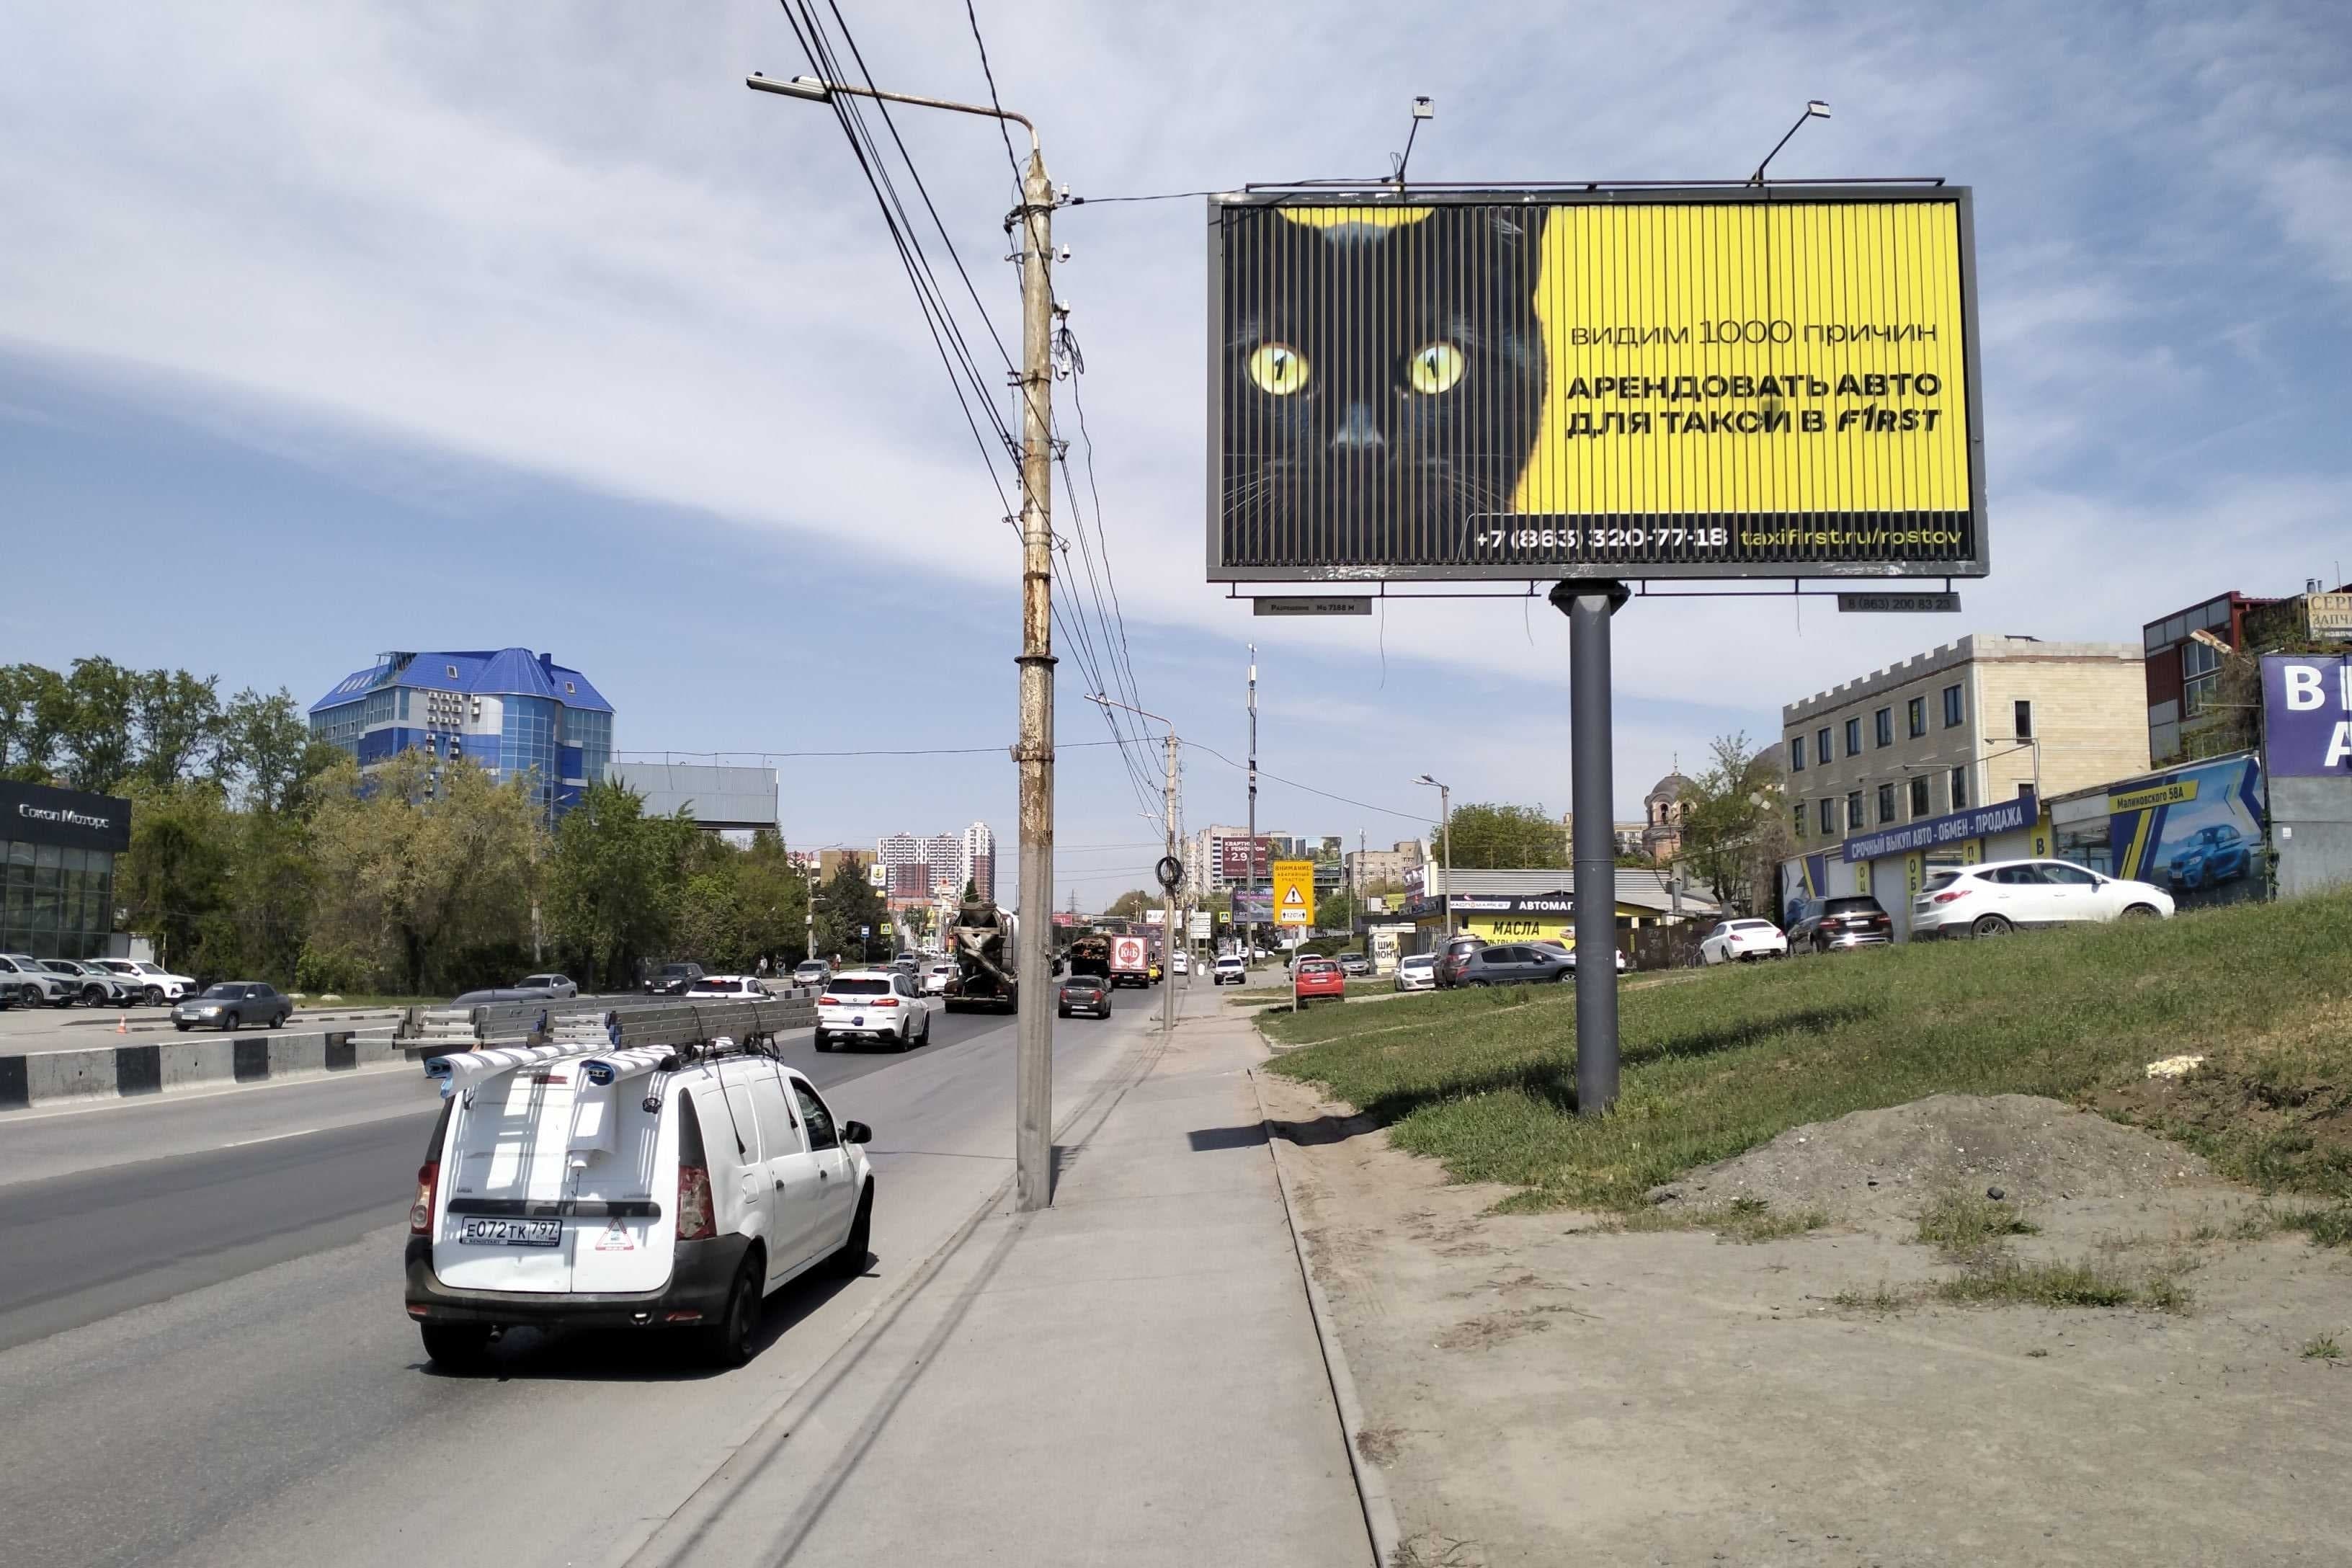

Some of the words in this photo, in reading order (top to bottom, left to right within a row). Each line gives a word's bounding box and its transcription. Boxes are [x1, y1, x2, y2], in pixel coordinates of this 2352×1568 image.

[1699, 320, 1793, 345] 1000
[1567, 373, 1830, 402] АРЕНДОВАТЬ
[1836, 373, 1943, 398] АВТО
[1567, 411, 1651, 438] ДЛЯ
[1660, 410, 1792, 435] ТАКСИ
[1802, 409, 1827, 433] В
[1474, 530, 1506, 548] +7
[1510, 528, 1584, 550] (863)
[1587, 527, 1728, 548] 320-77-18
[1740, 527, 1962, 547] taxifirst.ru/rostov
[1848, 600, 1856, 609] 8
[1859, 597, 1889, 610] (863)
[1892, 599, 1915, 609] 200
[1918, 599, 1933, 609] 83
[1936, 599, 1950, 609] 23
[2310, 596, 2352, 611] СЕР
[2312, 614, 2352, 625] ЗАПЧ
[2117, 791, 2168, 808] Малиновского
[2169, 786, 2184, 800] 58А
[19, 803, 60, 821] Сокол
[61, 809, 110, 829] Моторс
[1851, 833, 1885, 859] СРОЧНЫЙ
[1886, 831, 1911, 851] ВЫКУП
[1912, 827, 1933, 845] АВТО
[1938, 818, 1969, 841] ОБМЕН
[1975, 806, 2023, 834] ПРОДАЖА
[1519, 901, 1576, 911] АВТОМАГ
[1493, 921, 1540, 935] МАСЛА
[532, 1221, 556, 1235] 797
